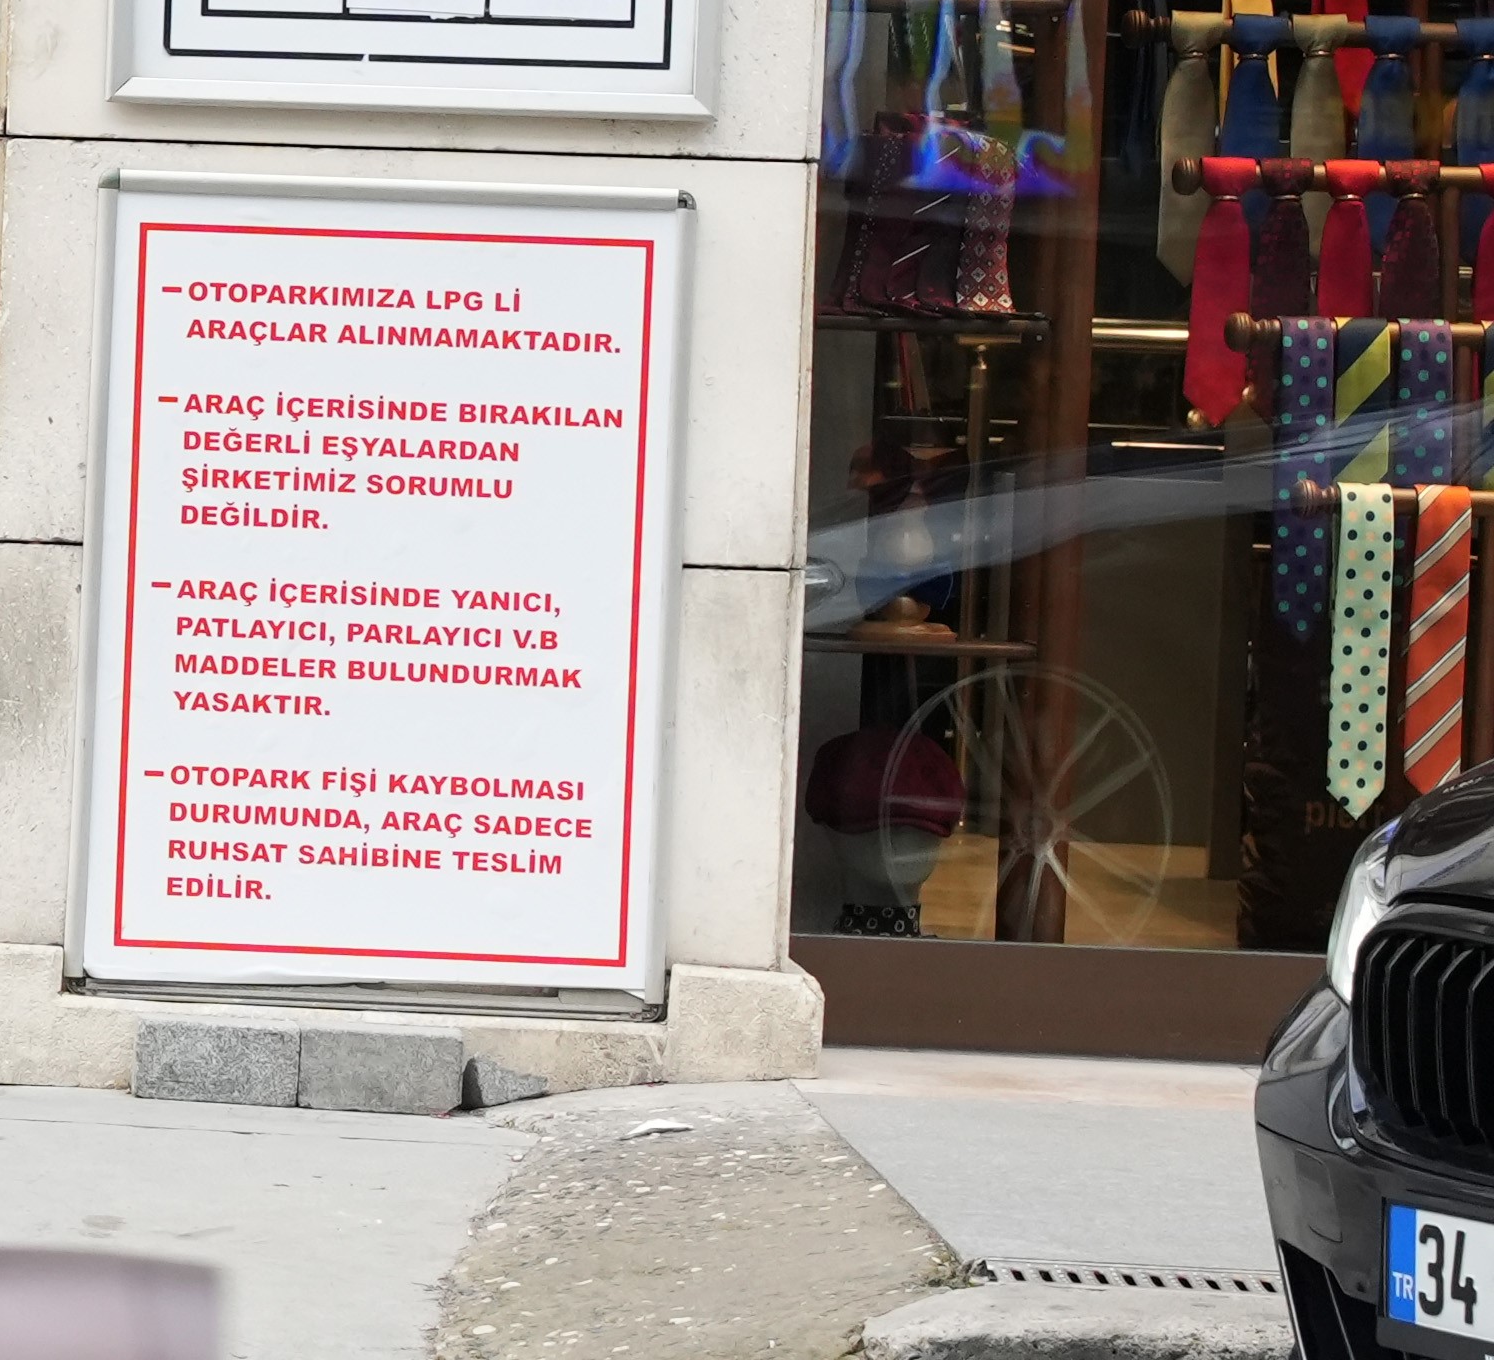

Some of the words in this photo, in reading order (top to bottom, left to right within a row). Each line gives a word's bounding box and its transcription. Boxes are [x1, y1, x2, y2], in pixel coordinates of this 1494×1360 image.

[426, 290, 484, 312] LPG
[495, 288, 521, 313] Lİ
[186, 319, 328, 346] ARAÇLAR
[338, 324, 622, 354] ALINMAMAKTADIR.
[276, 392, 447, 423] İÇERİSİNDE
[459, 403, 623, 428] BIRAKILAN
[183, 427, 311, 455] DEĞERLİ
[322, 435, 520, 463] EŞYALARDAN
[182, 467, 356, 495] ŞİRKETİMİZ
[367, 474, 513, 499] SORUMLU
[181, 502, 329, 530] DEĞİLDİR.
[269, 577, 441, 610] İÇERİSİNDE
[452, 590, 562, 617] YANICI,
[176, 616, 337, 646] PATLAYICI,
[347, 623, 502, 648] PARLAYICI
[513, 629, 559, 650] V.B
[174, 653, 337, 680] MADDELER
[347, 660, 583, 689] BULUNDURMAK
[174, 691, 331, 716] YASAKTIR.
[322, 767, 377, 798] FİŞİ
[388, 774, 585, 801] KAYBOLMASI
[169, 802, 370, 833] DURUMUNDA,
[381, 810, 462, 838] ARAÇ
[474, 814, 593, 839] SADECE
[168, 839, 288, 864] RUHSAT
[298, 842, 441, 871] SAHİBİNE
[453, 849, 562, 875] TESLİM
[166, 873, 272, 900] EDİLİR.
[1392, 1271, 1414, 1301] TR
[1418, 1224, 1477, 1325] 34
